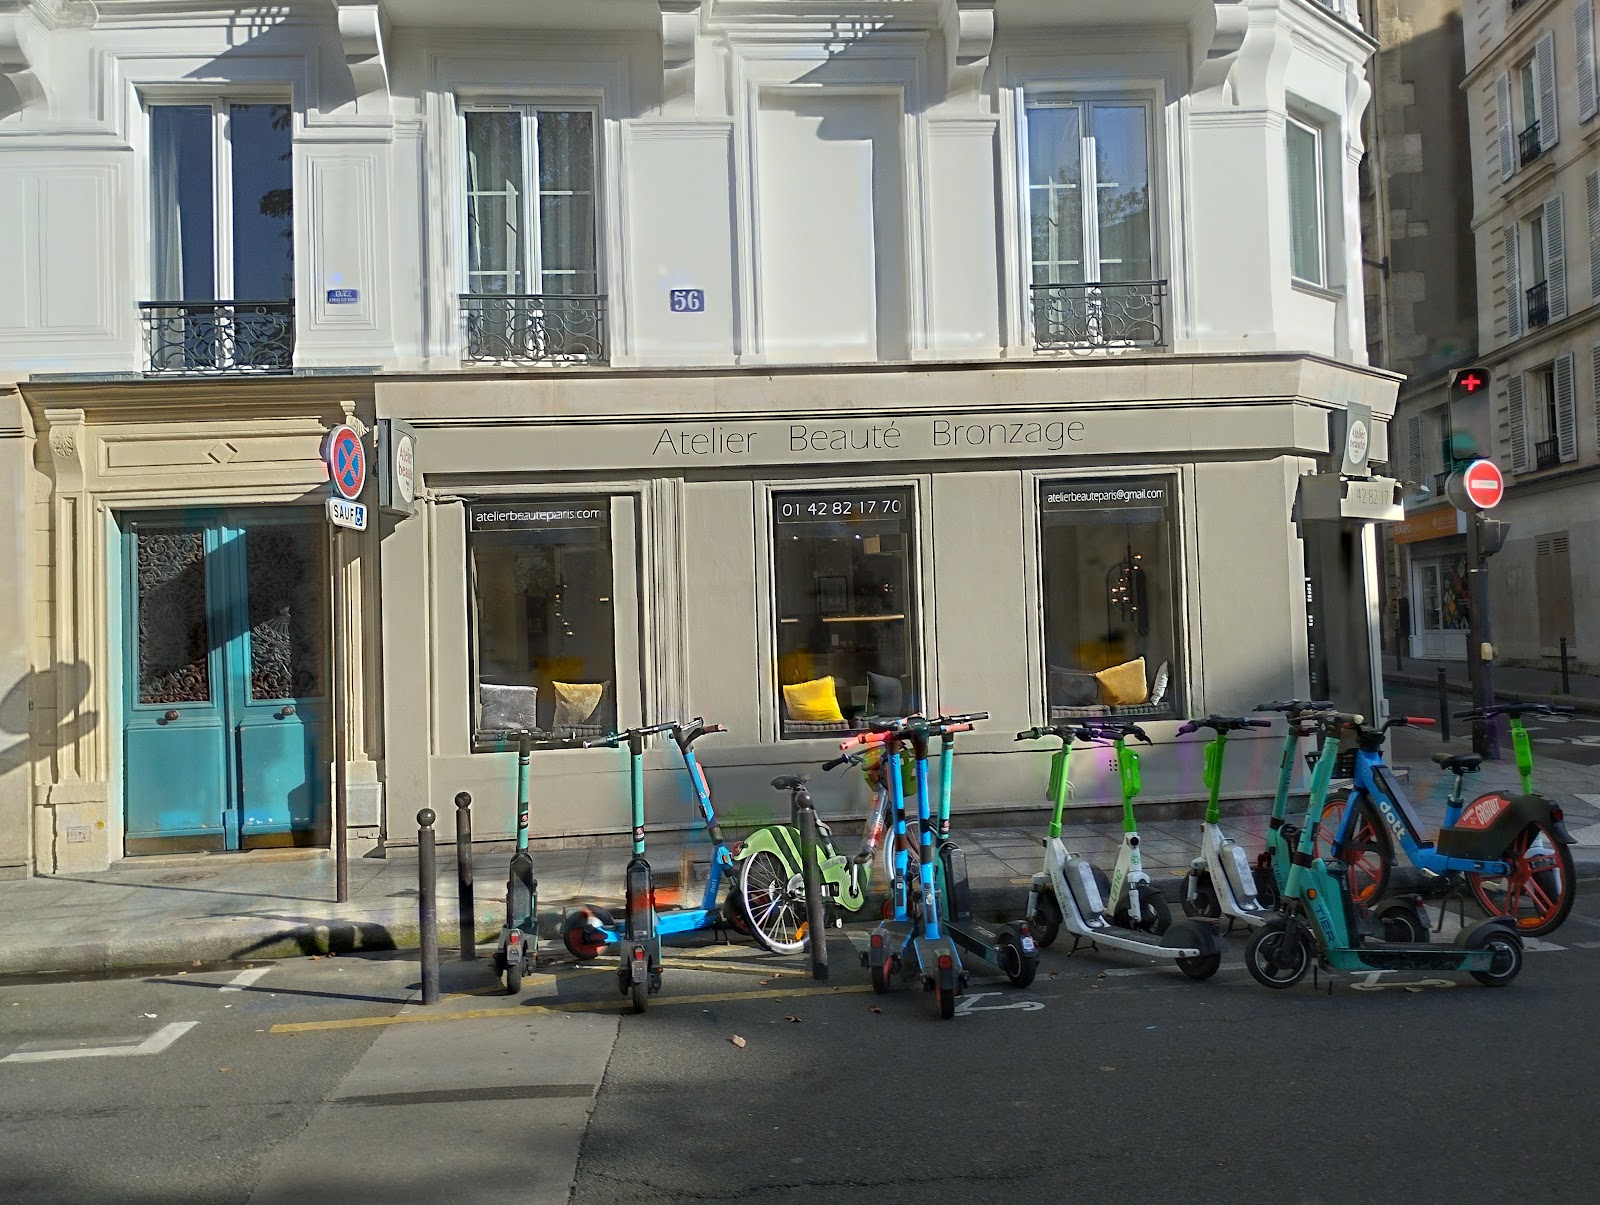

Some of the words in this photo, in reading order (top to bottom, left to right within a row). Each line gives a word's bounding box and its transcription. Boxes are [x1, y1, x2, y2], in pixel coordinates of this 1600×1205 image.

[674, 290, 700, 311] 56
[652, 428, 757, 456] Atelier
[790, 420, 901, 451] Beauté
[933, 419, 1085, 450] Bronzage
[1047, 488, 1165, 504] atelierbeauteparis@gmail.com
[1357, 488, 1367, 504] 42
[1368, 488, 1378, 505] 82
[333, 504, 354, 521] SAUF
[476, 508, 600, 522] atelierbeauteparis.com
[782, 503, 800, 517] 01
[807, 502, 828, 516] 42
[832, 501, 852, 515] 82
[860, 501, 877, 514] 17
[882, 499, 902, 513] 70
[1380, 801, 1405, 840] dott
[1316, 904, 1335, 942] TIER
